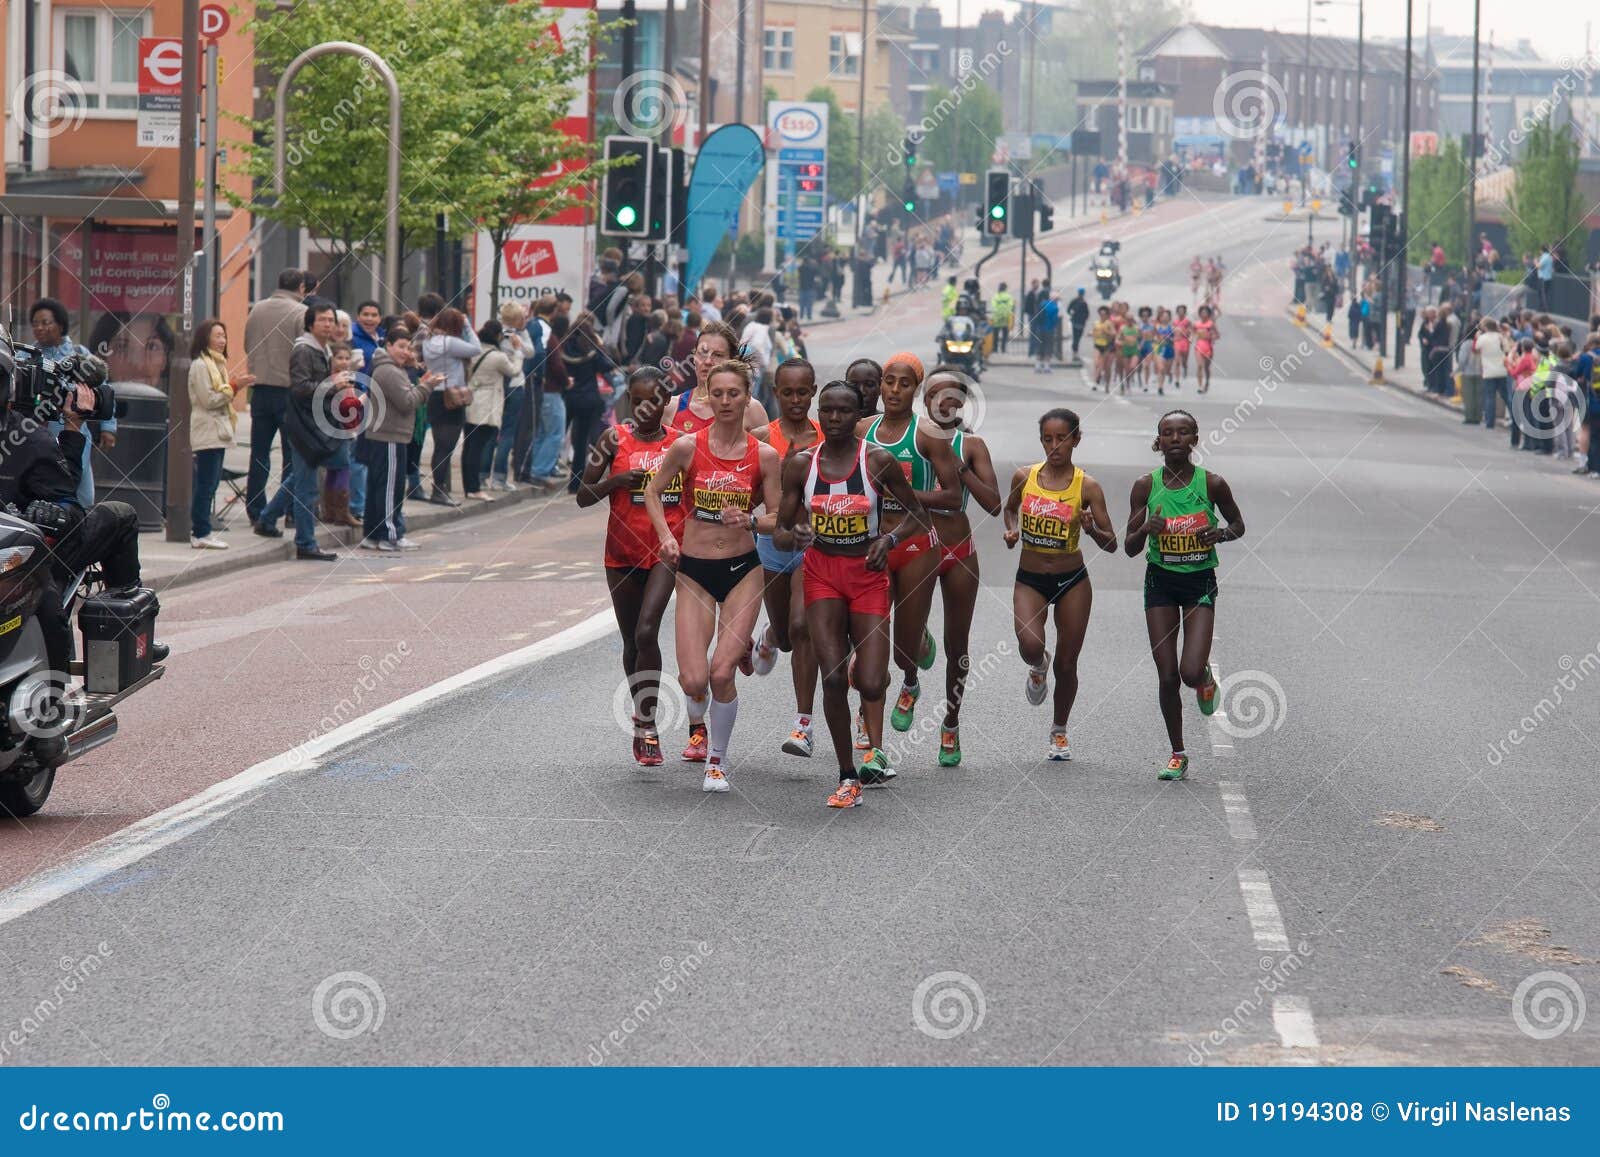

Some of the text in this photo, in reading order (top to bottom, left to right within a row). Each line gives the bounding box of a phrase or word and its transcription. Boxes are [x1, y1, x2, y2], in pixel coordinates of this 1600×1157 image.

[203, 9, 223, 33] D
[782, 117, 815, 132] Esso
[512, 241, 551, 276] Virgin
[499, 286, 565, 298] money
[704, 470, 738, 492] Virgin
[820, 494, 854, 516] Virgin
[1029, 495, 1058, 517] Virgin
[815, 515, 869, 534] PACE 1
[1022, 514, 1068, 538] BEKELE
[1167, 515, 1197, 536] Virgin
[835, 536, 865, 545] adidas
[1161, 535, 1205, 551] KEITAN
